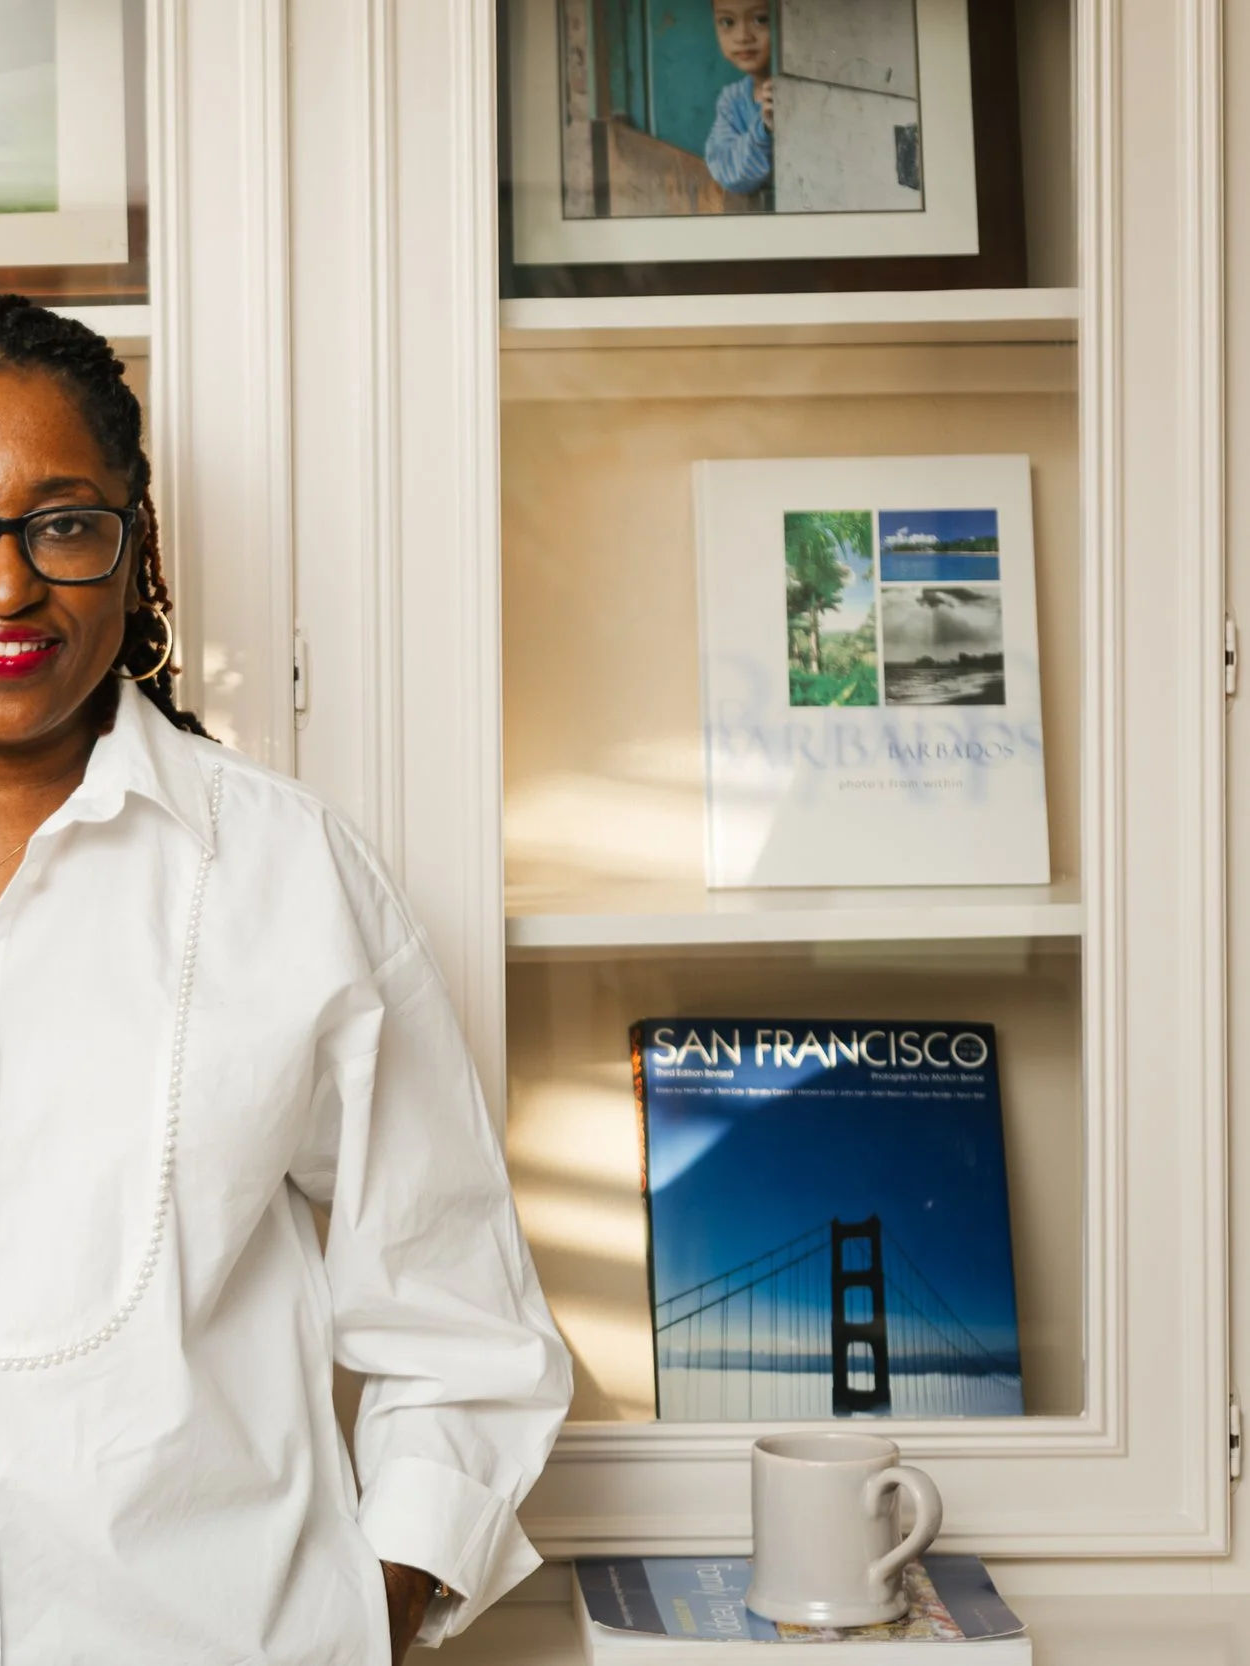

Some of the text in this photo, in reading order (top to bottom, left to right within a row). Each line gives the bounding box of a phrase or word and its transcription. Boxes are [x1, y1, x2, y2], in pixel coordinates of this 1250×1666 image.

[887, 741, 1014, 760] BARBADOS
[888, 778, 919, 789] from
[923, 777, 963, 789] within
[652, 1027, 742, 1067] SAN
[755, 1029, 988, 1068] FRANCISCO
[655, 1067, 734, 1080] Third Edition Revised
[870, 1071, 918, 1083] Photographs
[919, 1072, 930, 1083] by
[691, 1563, 746, 1636] Family Therapy
